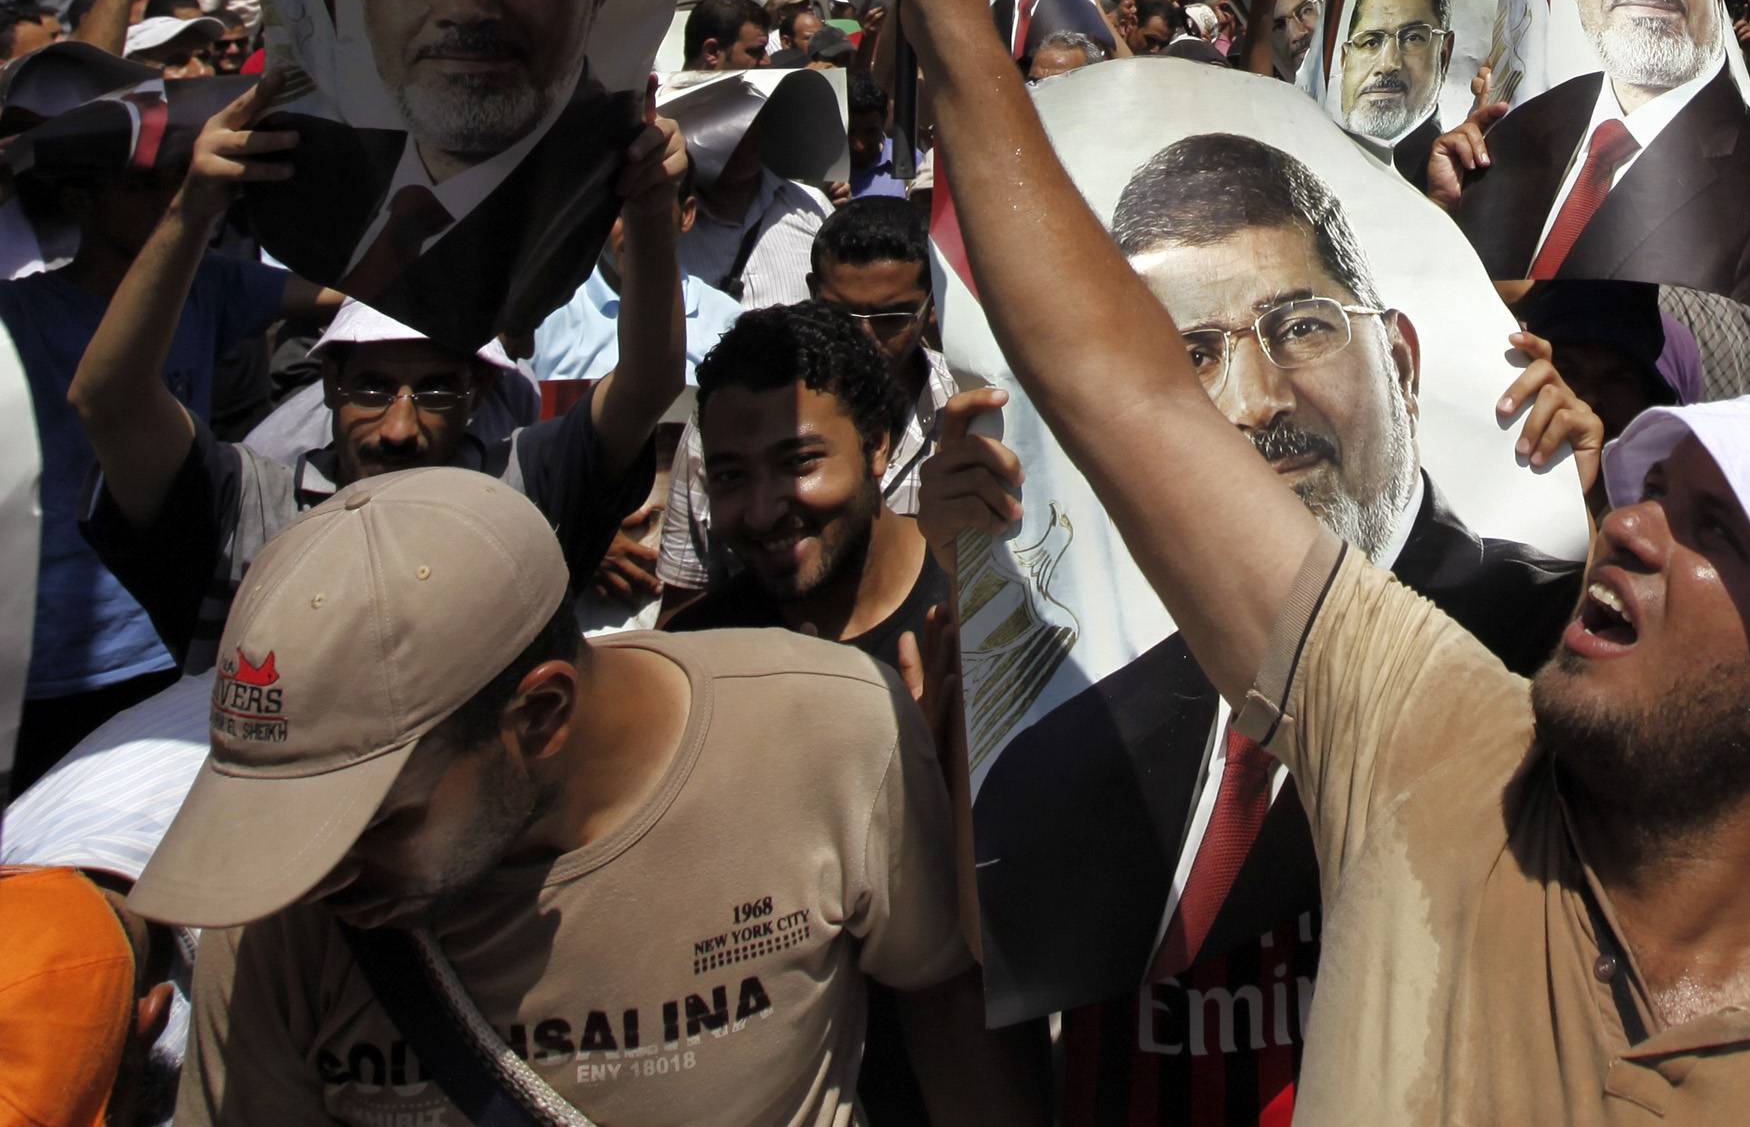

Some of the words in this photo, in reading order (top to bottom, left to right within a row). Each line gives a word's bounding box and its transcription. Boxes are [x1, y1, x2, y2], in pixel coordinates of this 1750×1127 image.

[733, 896, 774, 925] 1968
[693, 933, 729, 955] NEW
[730, 921, 774, 944] YORK
[776, 908, 810, 931] CITY
[576, 1063, 622, 1084] ENY
[630, 1050, 697, 1078] 18018
